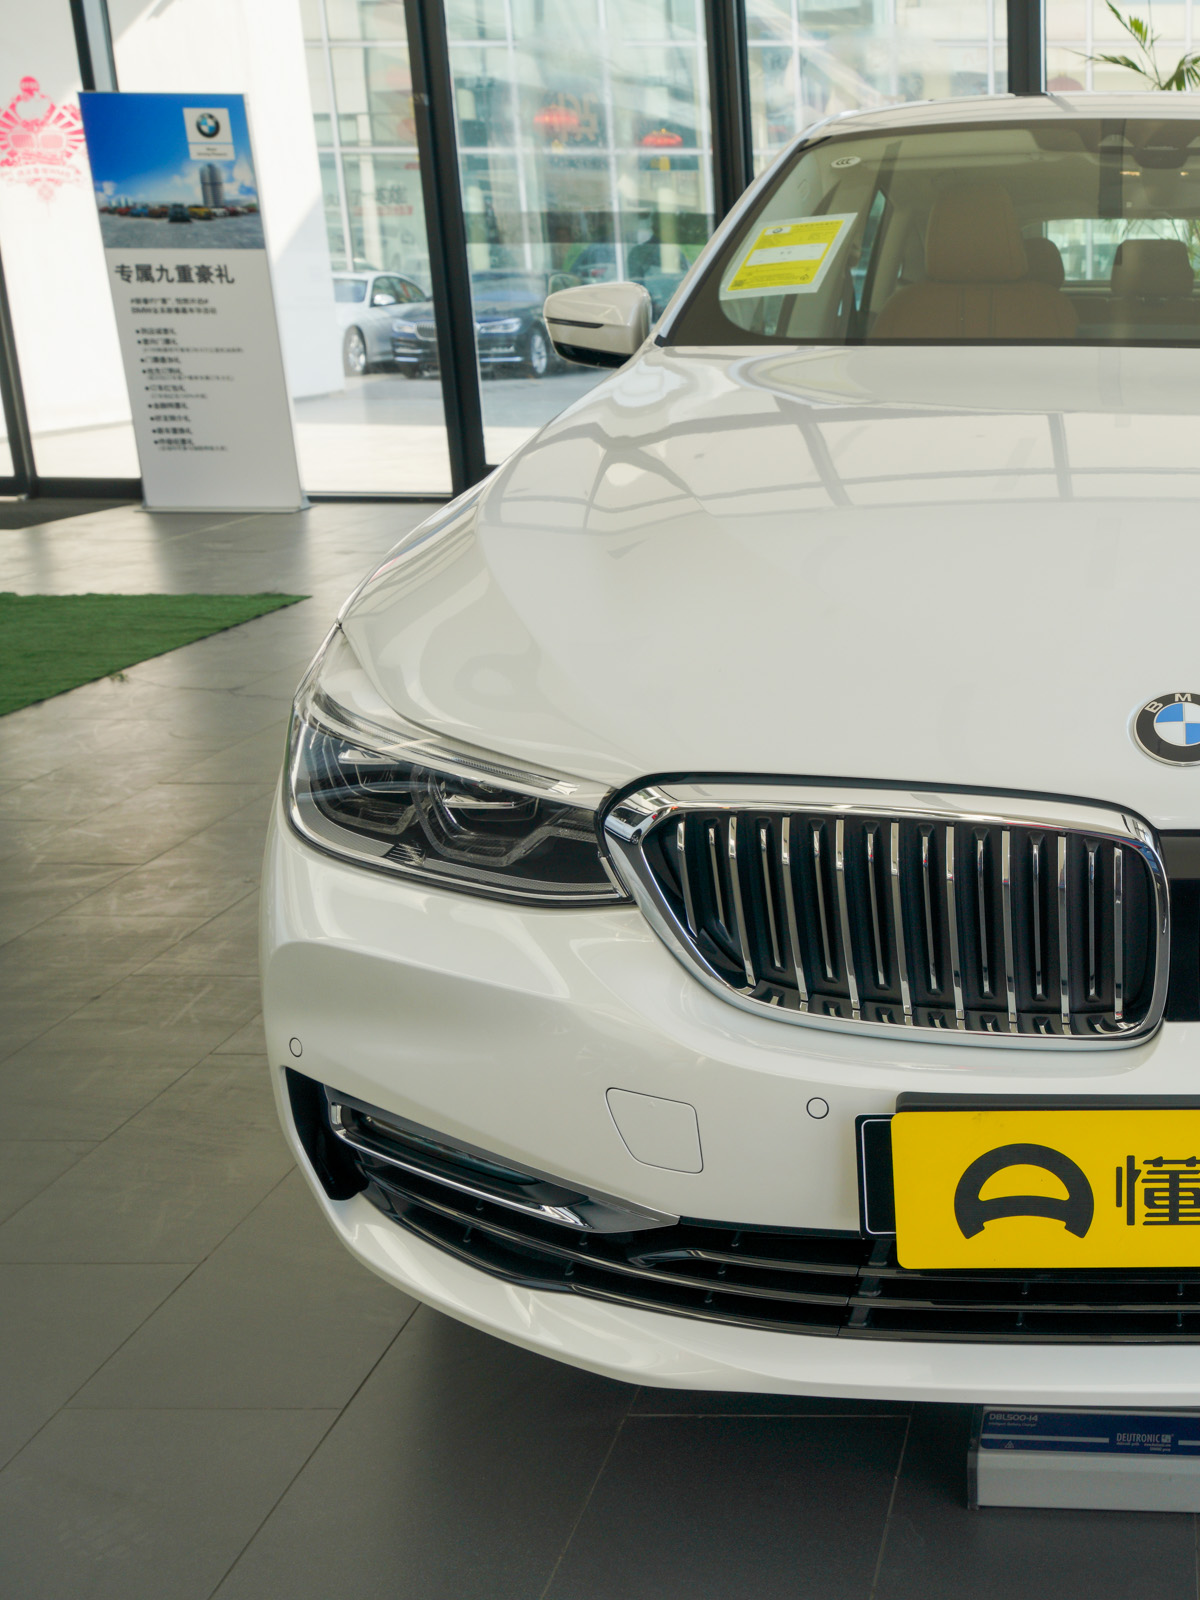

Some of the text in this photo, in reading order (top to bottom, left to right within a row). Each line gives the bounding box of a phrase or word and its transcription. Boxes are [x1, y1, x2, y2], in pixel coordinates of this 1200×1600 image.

[115, 264, 235, 284] 专属九重豪礼
[1116, 1432, 1160, 1443] DEUTRONIC
